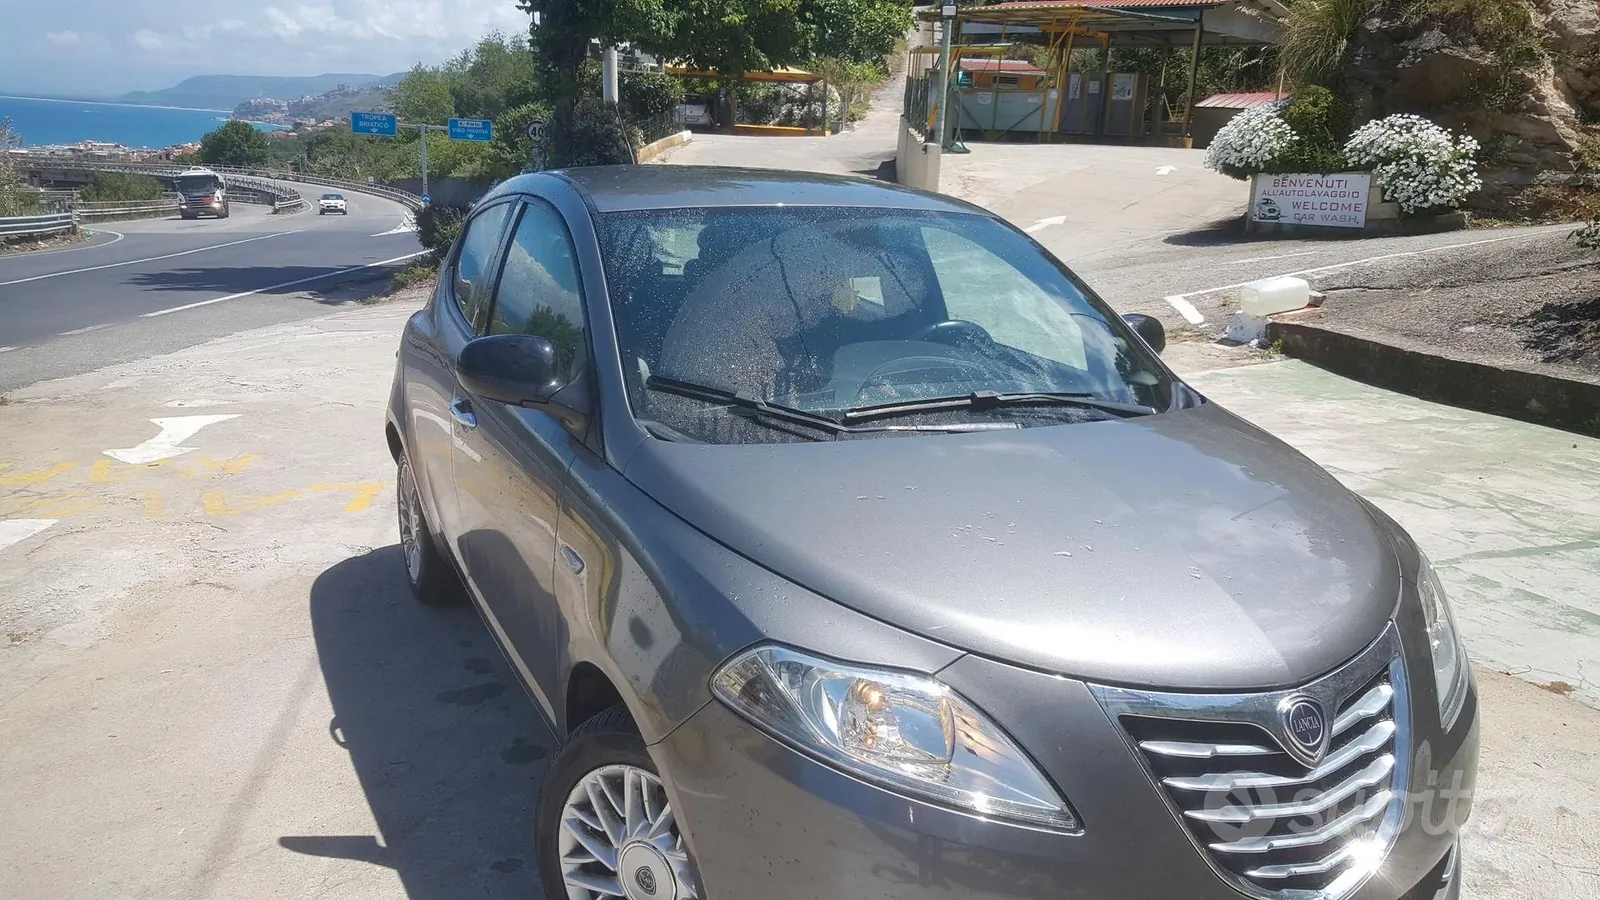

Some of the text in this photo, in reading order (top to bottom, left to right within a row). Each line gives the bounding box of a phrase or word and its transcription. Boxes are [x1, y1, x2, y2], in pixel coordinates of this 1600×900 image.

[360, 114, 387, 122] TROPEA
[359, 121, 390, 129] BRIATICO
[531, 126, 544, 138] 40
[1273, 178, 1348, 189] BENVENUTI
[1261, 189, 1360, 199] ALL'AUTOLAVAGGIO
[1292, 201, 1363, 212] WELCOME
[1293, 213, 1316, 221] CAR
[1293, 715, 1320, 733] LANCIA
